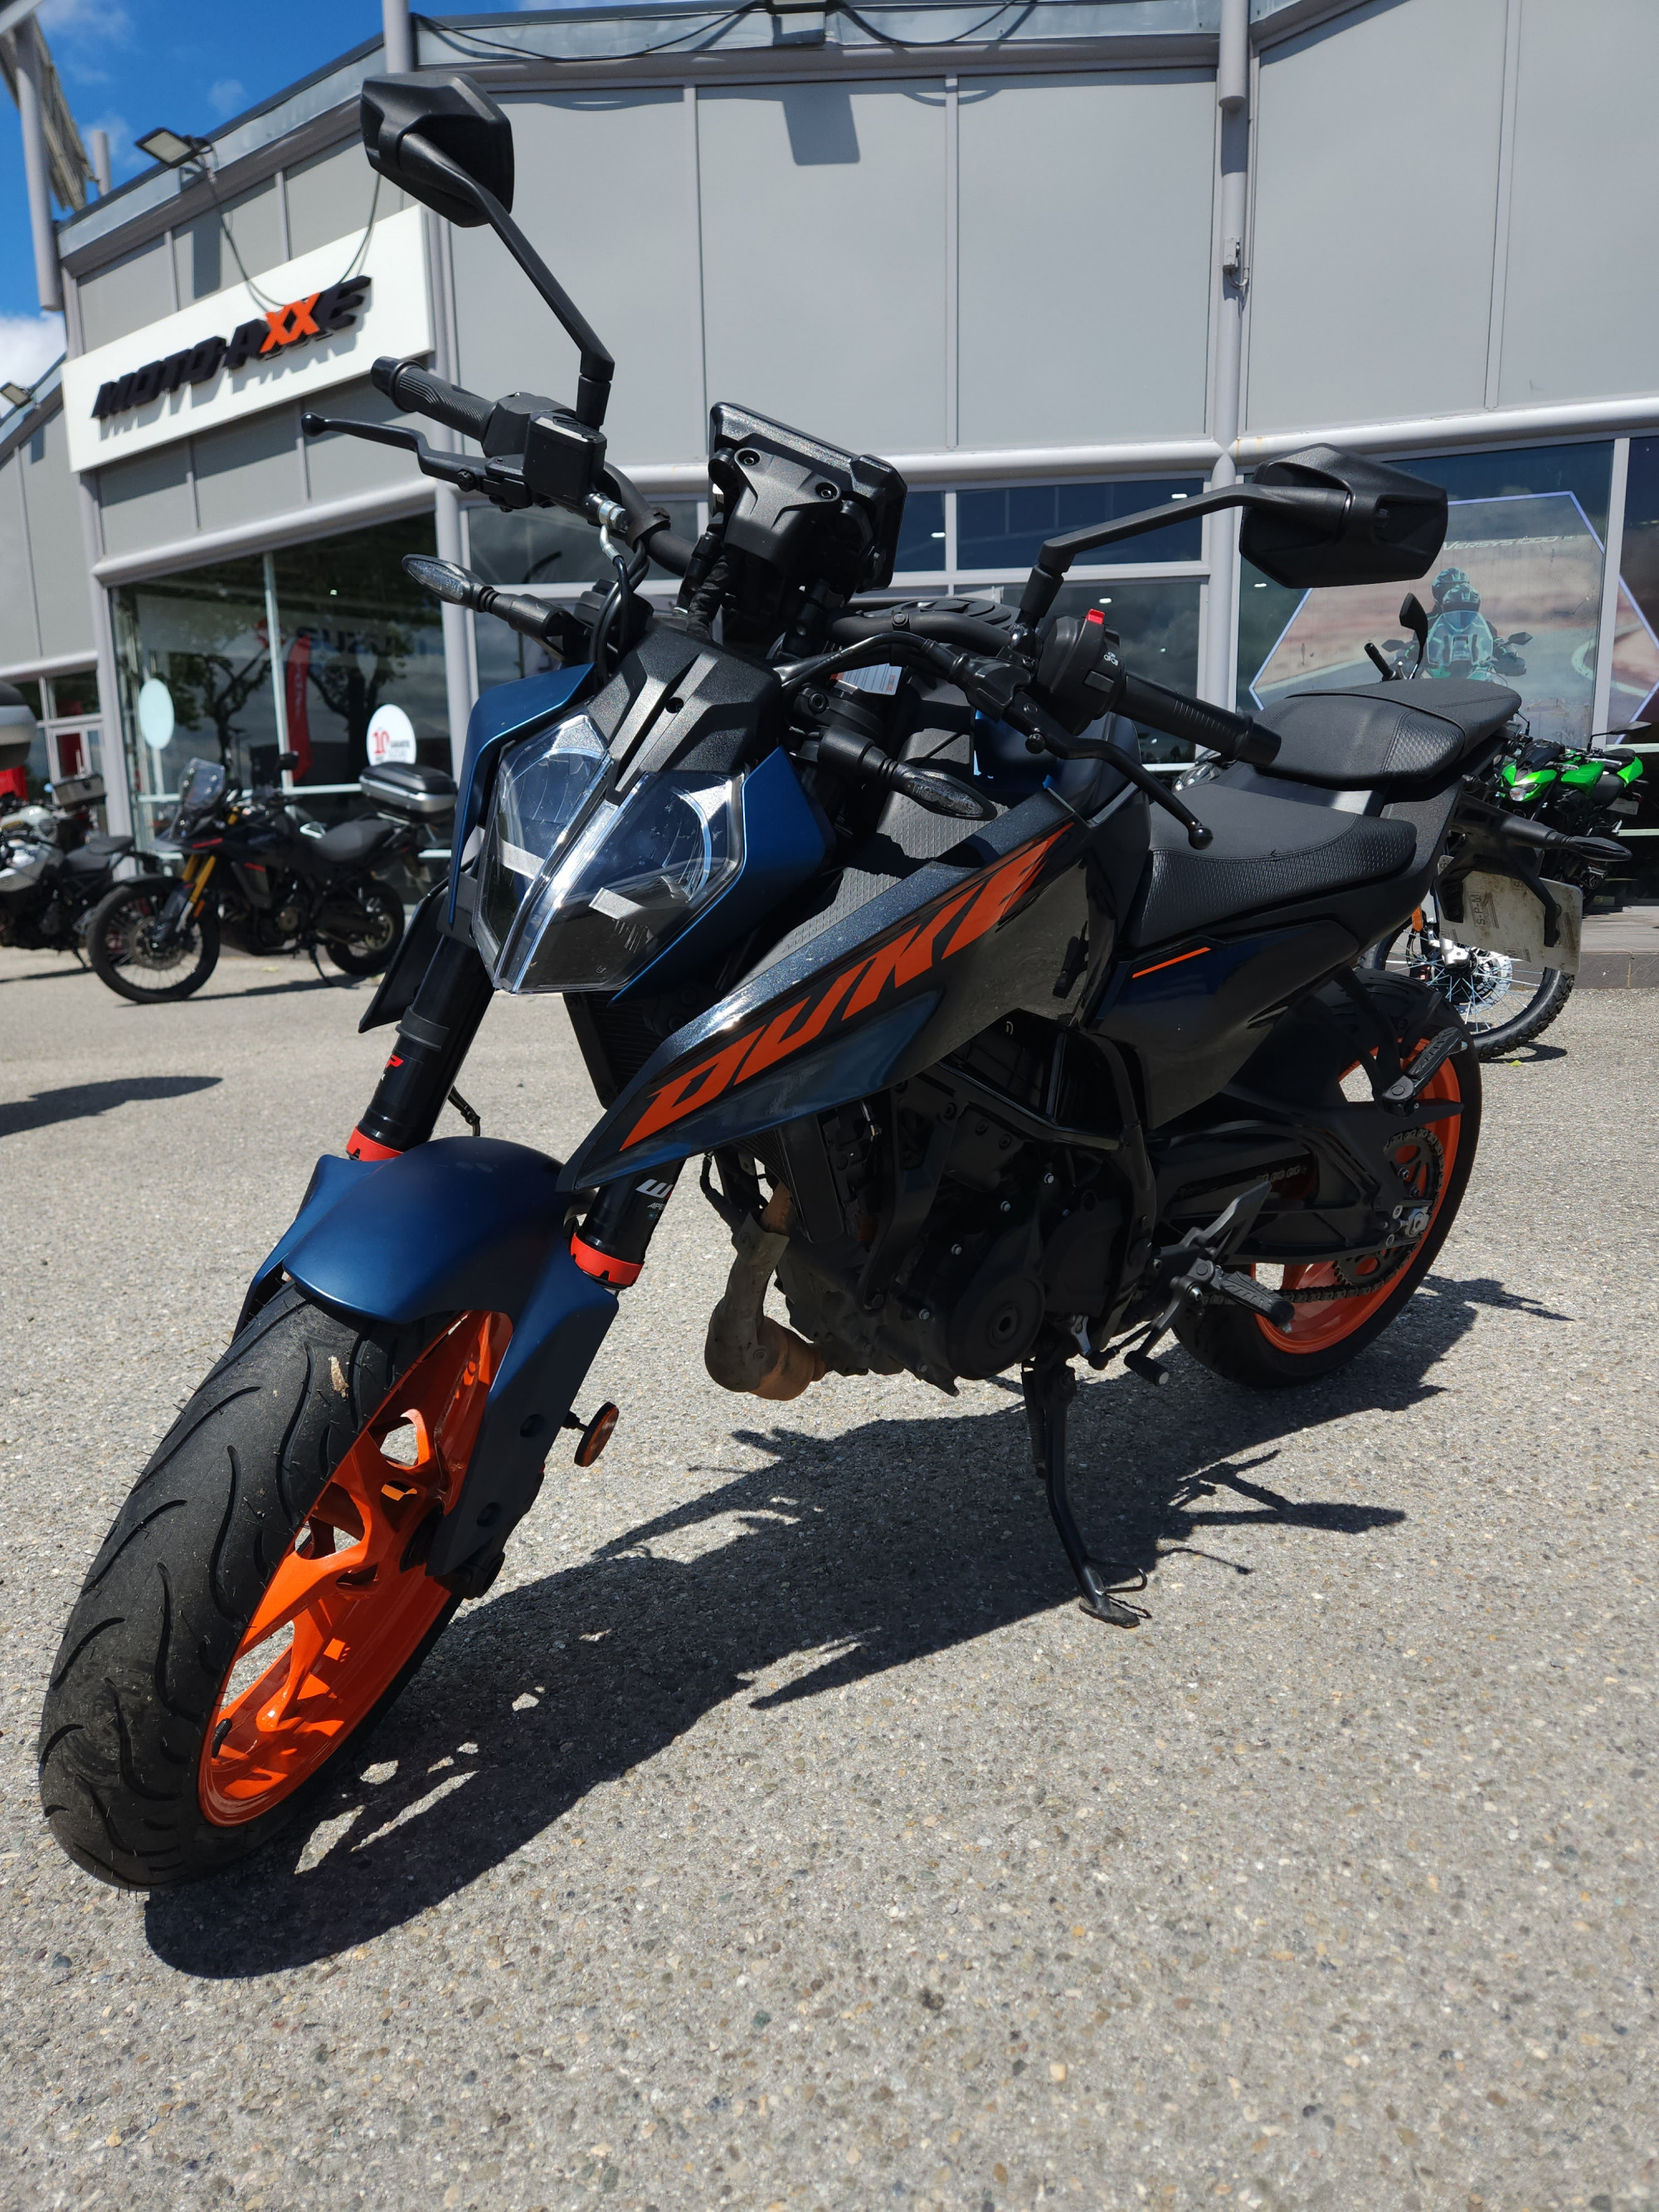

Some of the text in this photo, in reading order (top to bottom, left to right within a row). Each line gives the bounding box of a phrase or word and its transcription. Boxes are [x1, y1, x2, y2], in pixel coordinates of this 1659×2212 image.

[1443, 539, 1515, 551] VERSYS
[1515, 536, 1559, 546] 1000
[619, 821, 1074, 1152] DUKE
[635, 1179, 674, 1200] W
[647, 1202, 666, 1211] APE
